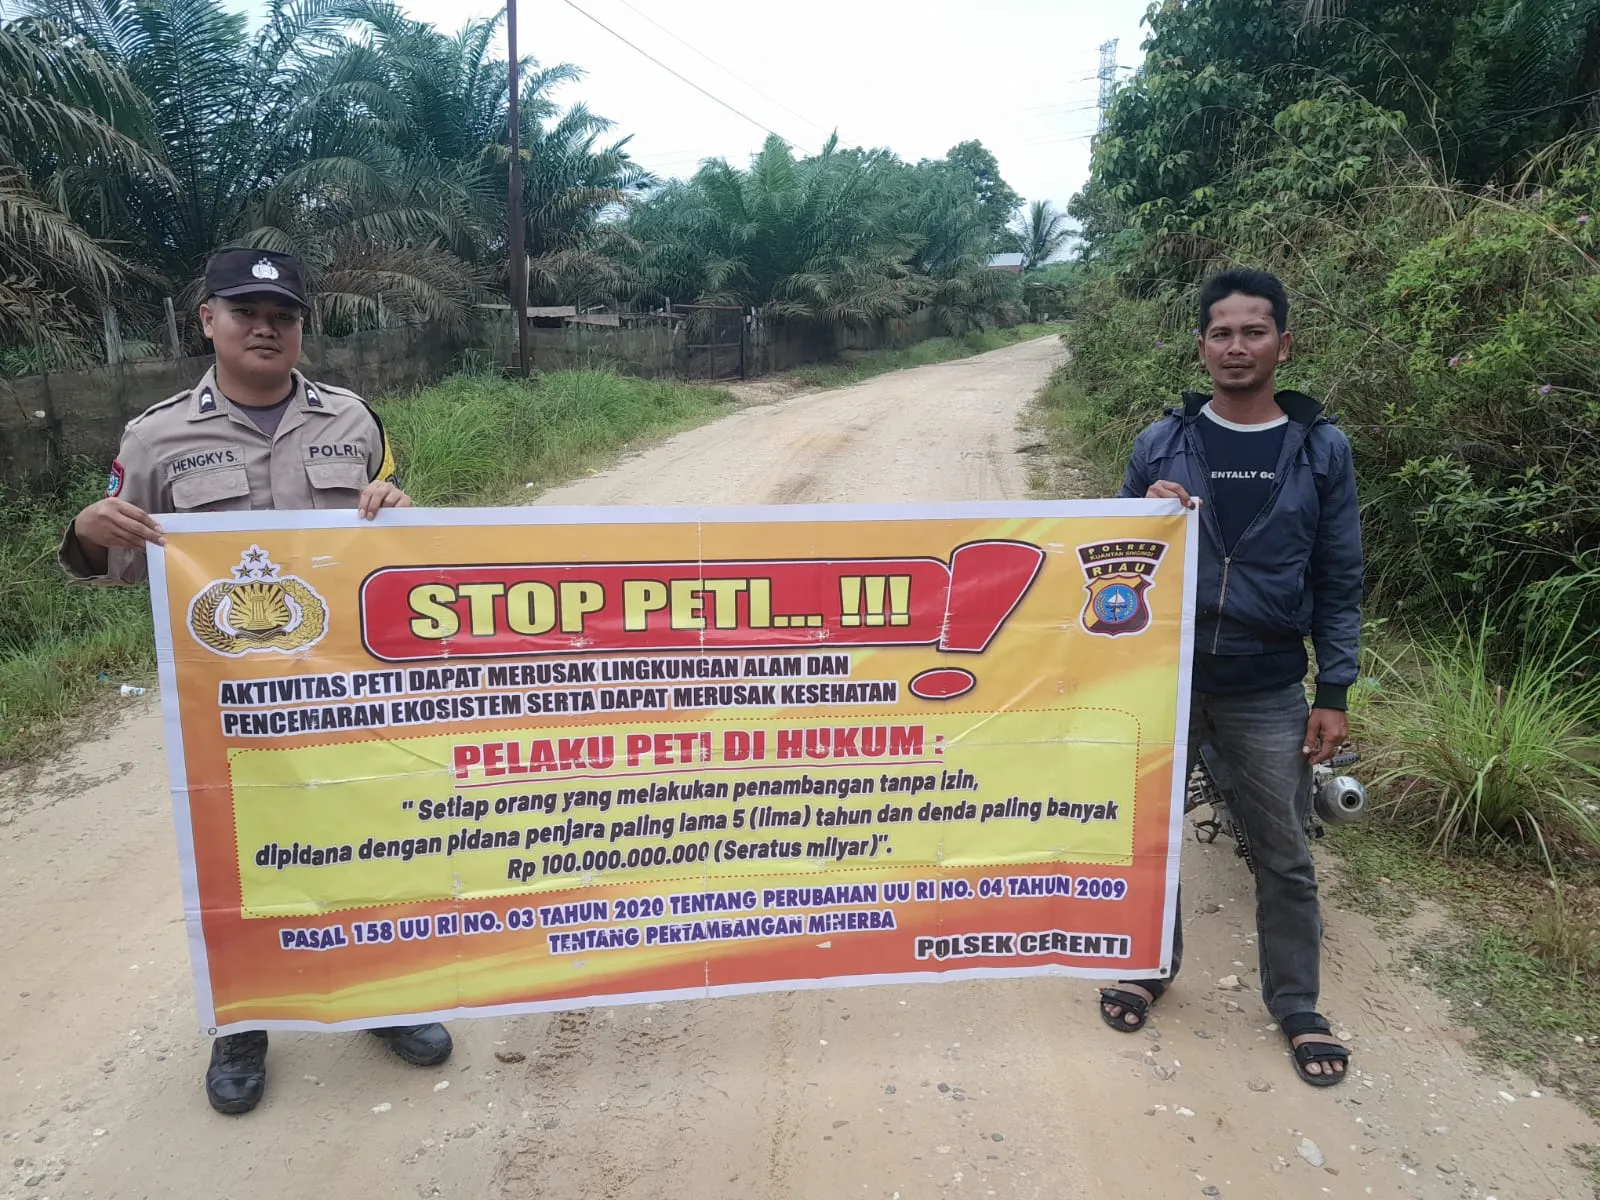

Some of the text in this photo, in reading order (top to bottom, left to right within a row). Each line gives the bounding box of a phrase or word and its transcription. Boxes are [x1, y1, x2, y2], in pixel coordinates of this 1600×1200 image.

[172, 451, 223, 474] HENGKY
[309, 444, 358, 458] POLRI
[1088, 543, 1157, 555] POLRES
[1092, 562, 1146, 576] RIAU
[408, 574, 912, 641] STOP PETI... !!!
[221, 655, 849, 704] AKTIVITAS PETI DAPAT MERUSAK LINGKUNGAN ALAM DAN
[224, 682, 897, 735] PENCEMARAN EKOSISTEM SERTA DAPAT MERUSAK KESEHATAN
[454, 735, 614, 779] PELAKU
[627, 732, 711, 767] PETI
[724, 729, 765, 761] DI
[777, 725, 924, 760] HUKUM
[495, 793, 557, 814] orang
[561, 790, 612, 812] yang
[617, 779, 728, 804] melakukan
[733, 775, 874, 801] penambangan
[880, 773, 936, 795] tanpa
[255, 797, 1119, 869] dipidana dengan pidana penjara paling lama 5 (lima) tahun dan denda paling banyak
[507, 858, 536, 882] Rp
[541, 841, 709, 875] 100.000.000.000
[714, 839, 801, 863] (Seratus
[281, 876, 1126, 949] PASAL 158 UU RI NO. 03 TAHUN 2020 TENTANG PERUBAHAN UU RI NO. 04 TAHUN 2009
[549, 911, 895, 953] TENTANG PERTAMBANGAN MINERBA
[918, 931, 1129, 958] POLSEK CERENTI
